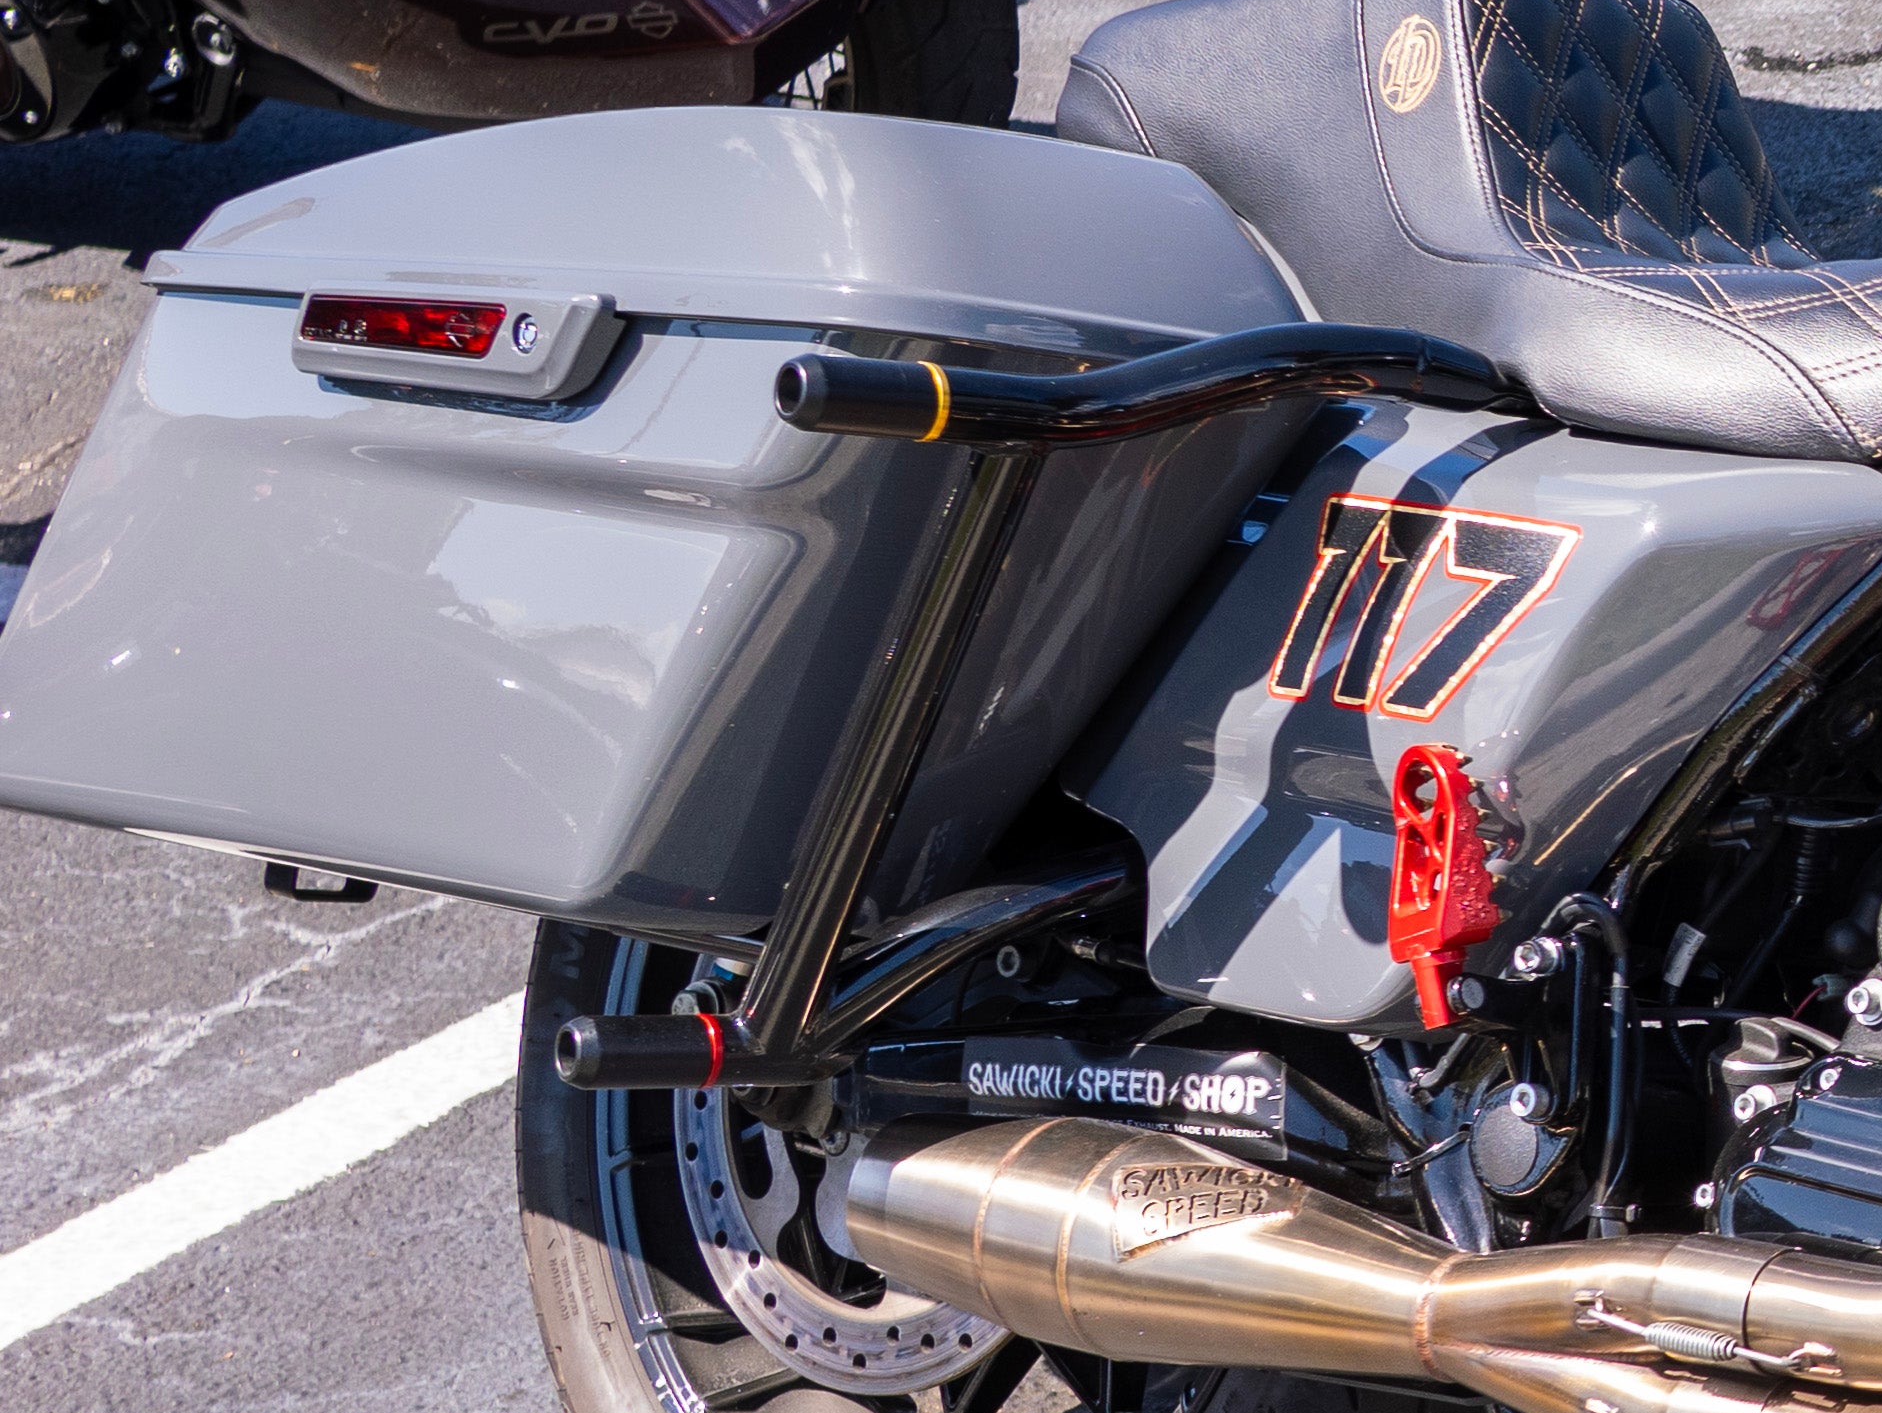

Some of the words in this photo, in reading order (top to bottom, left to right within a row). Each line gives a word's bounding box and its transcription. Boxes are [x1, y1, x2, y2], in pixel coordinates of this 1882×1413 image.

[482, 12, 620, 45] CVO
[1267, 491, 1584, 724] 117
[967, 1061, 1064, 1101] SAWICKI
[1076, 1065, 1166, 1108] SPEED
[1181, 1073, 1273, 1116] SHOP
[1174, 1123, 1202, 1136] MADE
[1217, 1126, 1273, 1139] AMERICA.
[1141, 1188, 1269, 1237] SPEED
